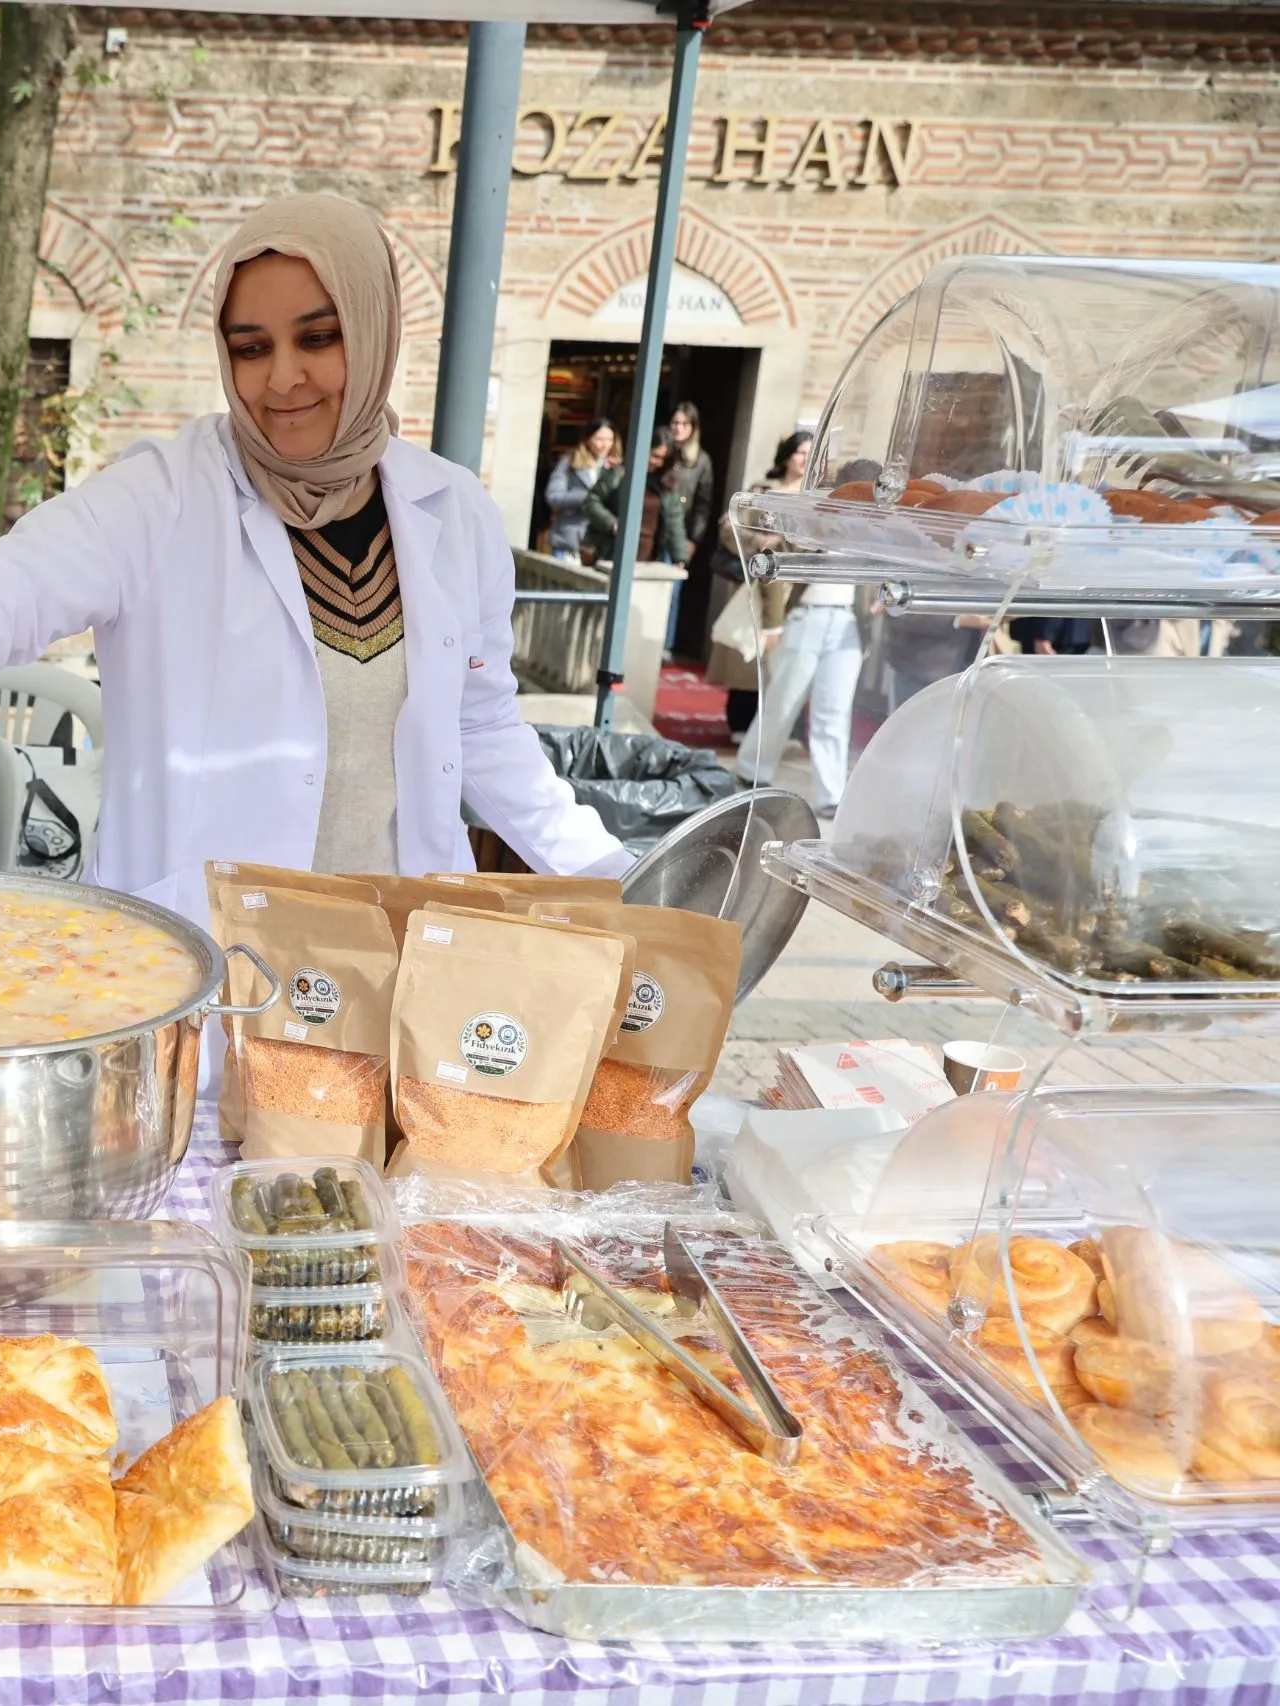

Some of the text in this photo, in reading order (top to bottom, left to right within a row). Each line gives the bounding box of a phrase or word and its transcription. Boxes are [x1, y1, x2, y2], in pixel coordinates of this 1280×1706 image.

[713, 114, 925, 186] HAN
[618, 291, 724, 312] KO HAN
[628, 1001, 653, 1012] ekızık
